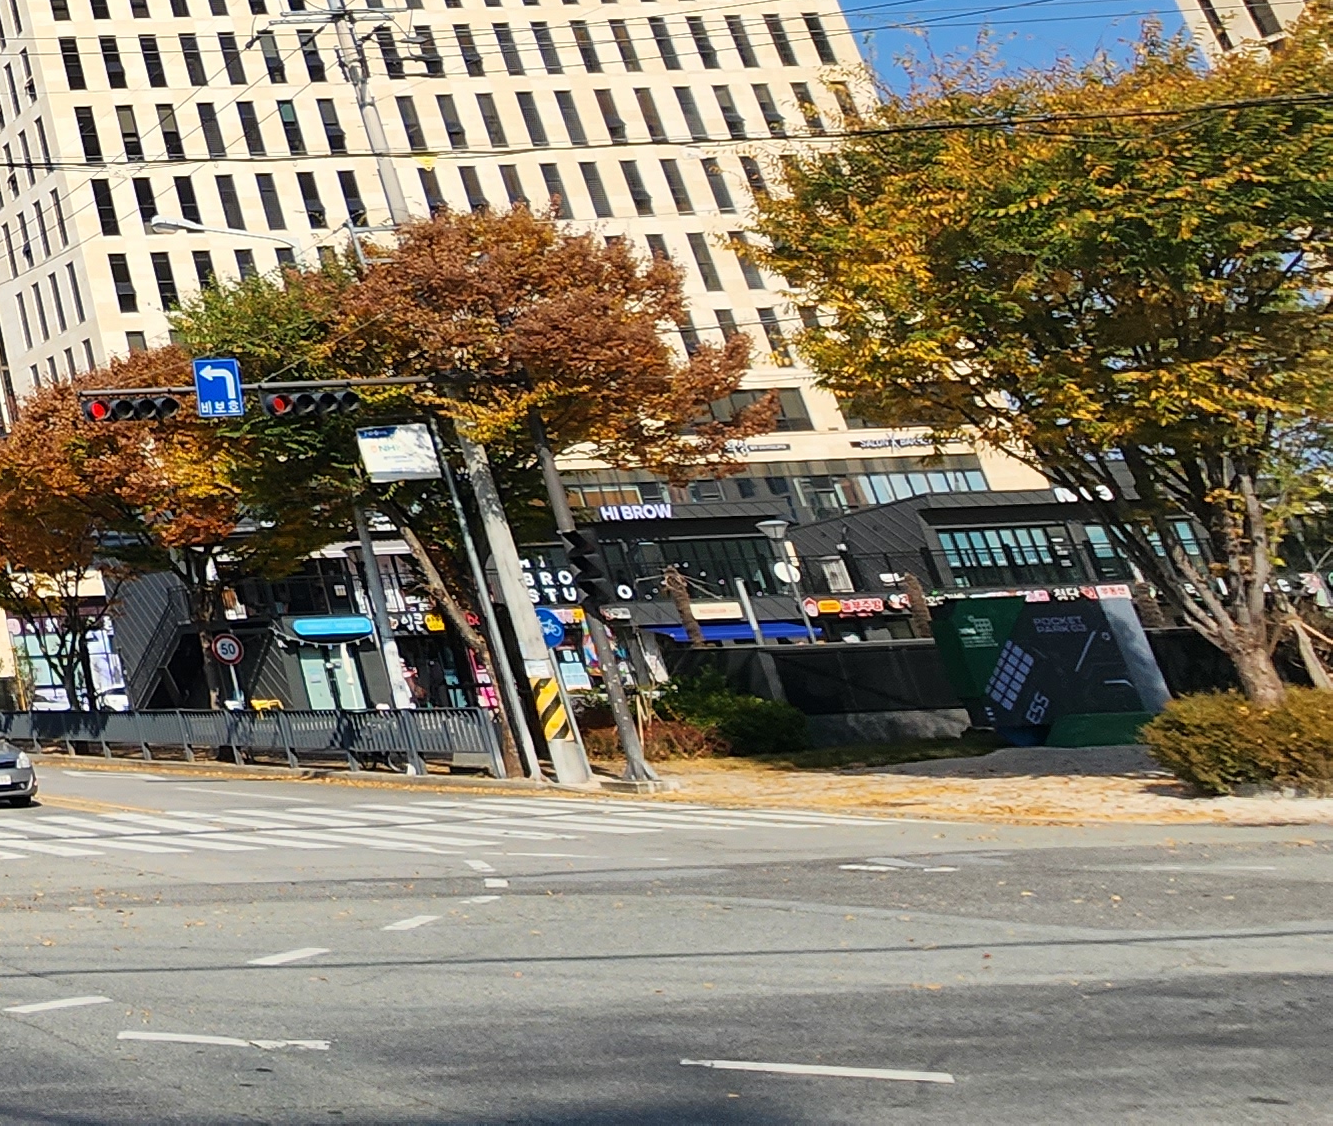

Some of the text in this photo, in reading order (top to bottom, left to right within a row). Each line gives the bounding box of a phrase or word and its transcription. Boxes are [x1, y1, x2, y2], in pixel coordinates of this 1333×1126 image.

[200, 399, 241, 414] 비보호
[600, 503, 673, 521] HI BROW
[220, 642, 236, 656] 50
